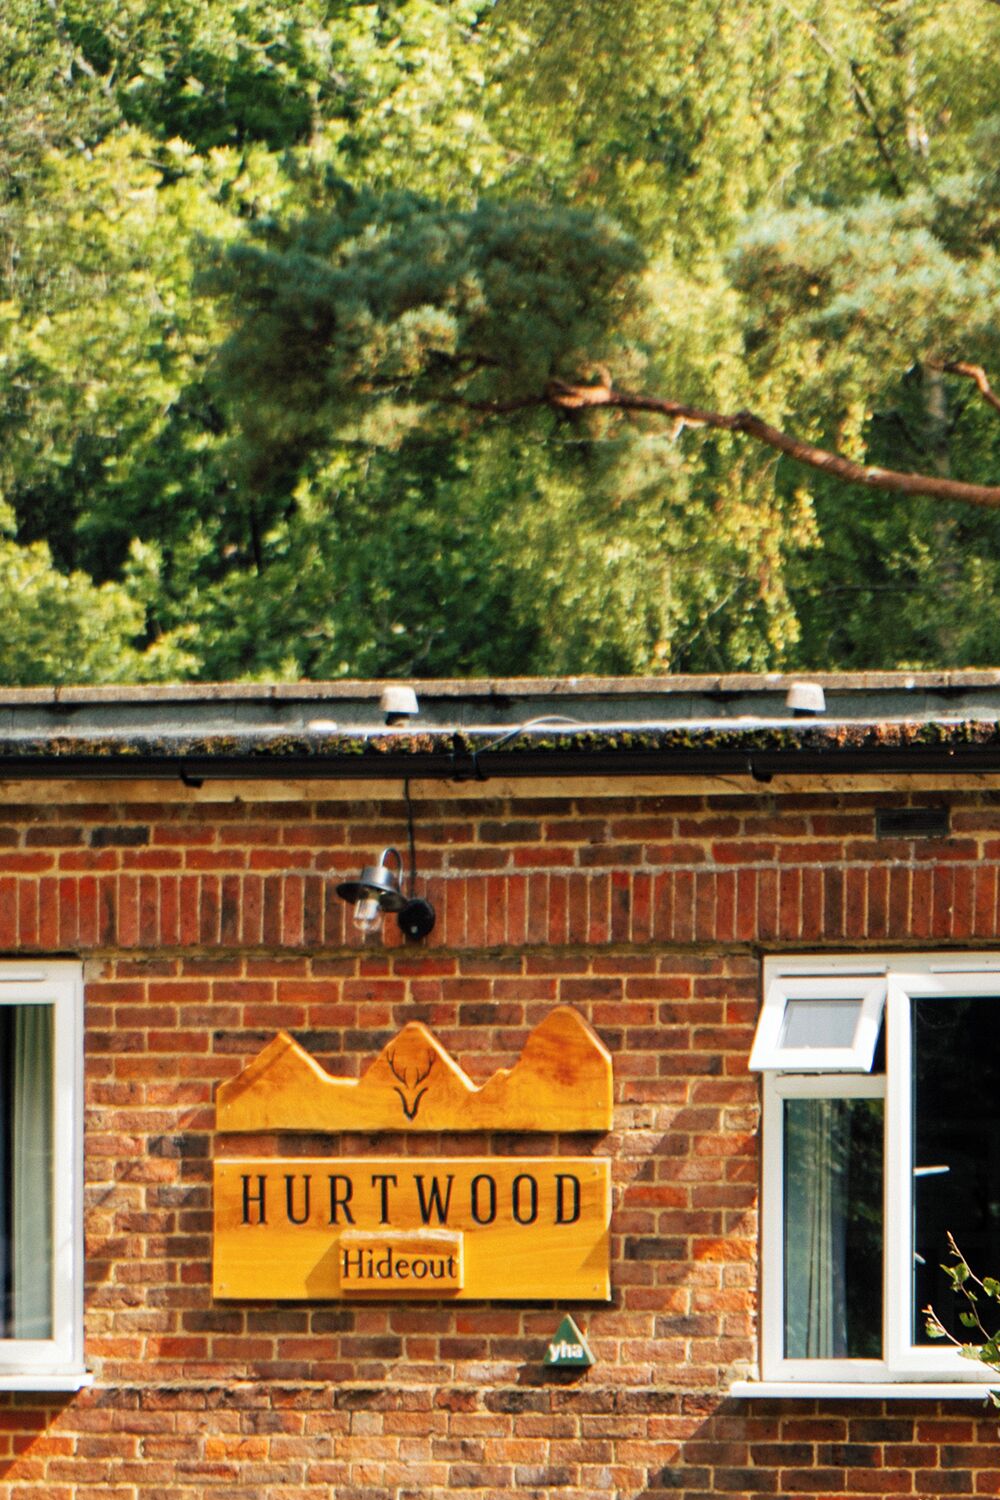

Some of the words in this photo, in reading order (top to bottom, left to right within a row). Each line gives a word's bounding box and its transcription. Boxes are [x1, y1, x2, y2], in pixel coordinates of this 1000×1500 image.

[240, 1173, 582, 1226] HURTWOOD
[342, 1248, 457, 1279] Hideout
[549, 1340, 584, 1362] yha
